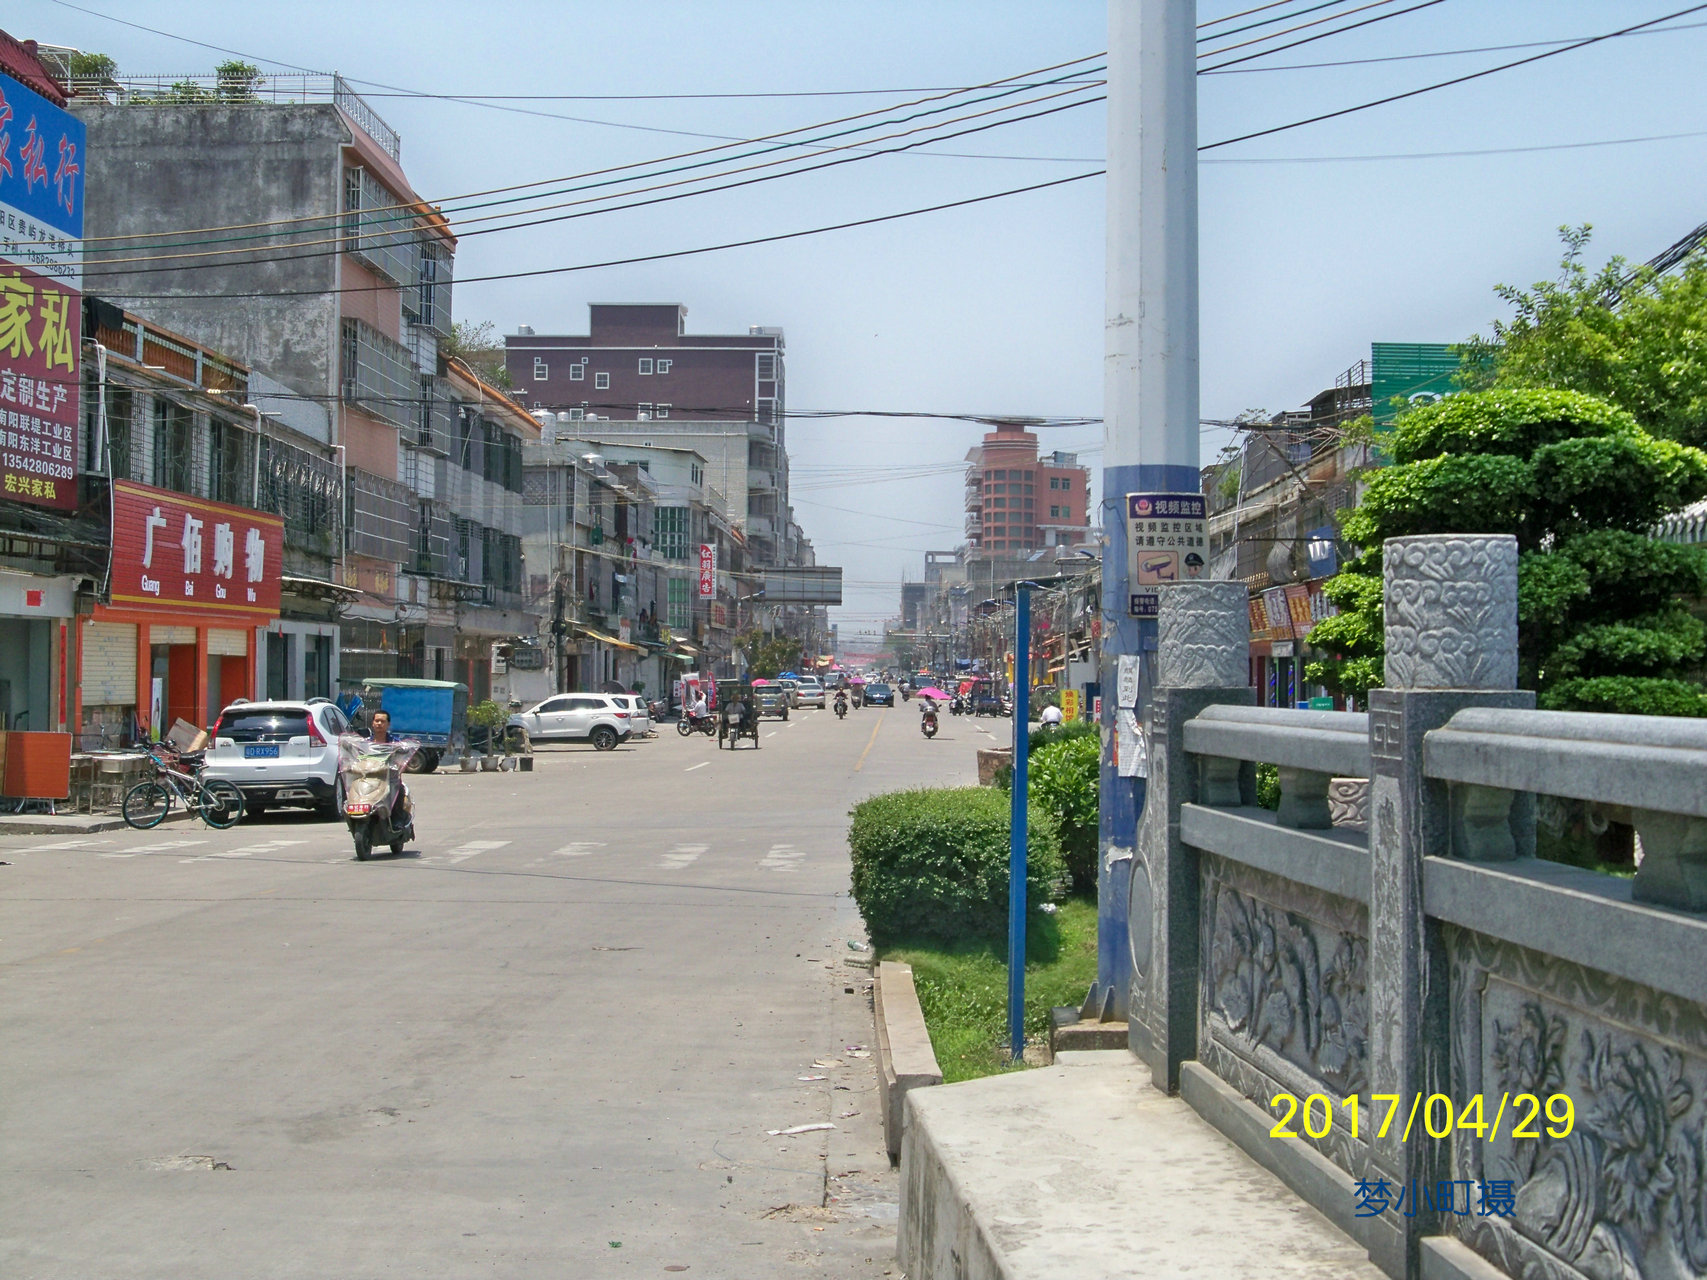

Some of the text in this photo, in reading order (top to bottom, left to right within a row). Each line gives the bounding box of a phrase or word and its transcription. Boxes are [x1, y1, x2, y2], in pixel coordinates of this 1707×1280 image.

[0, 271, 75, 374] 家私
[2, 452, 74, 480] 13542806289
[4, 473, 57, 500] 宏兴家私
[1155, 500, 1202, 515] 视频监控
[1135, 522, 1203, 533] 视频监控区域
[141, 575, 256, 603] Guang Bai Gou Wu
